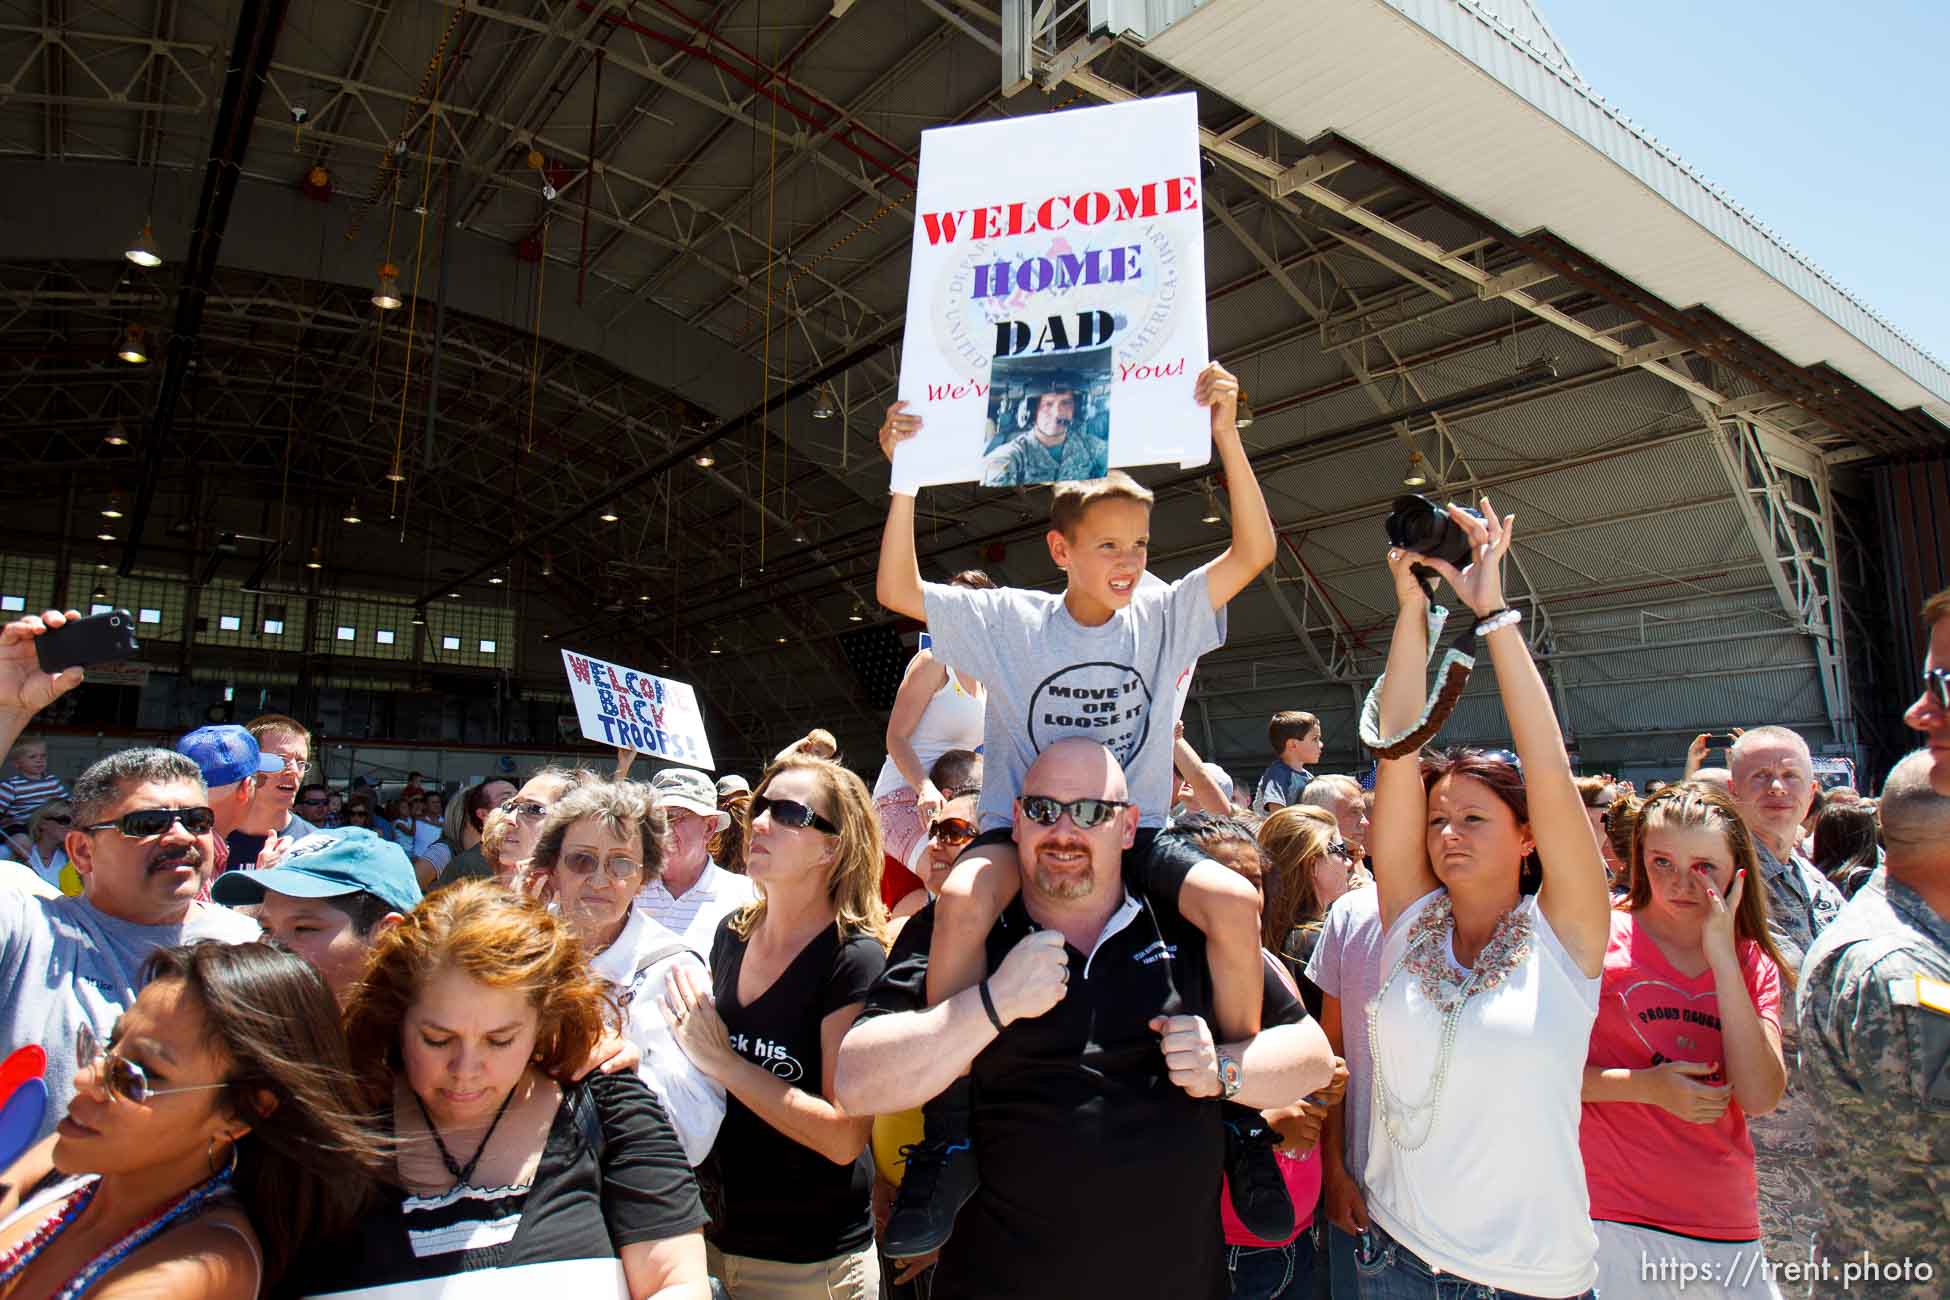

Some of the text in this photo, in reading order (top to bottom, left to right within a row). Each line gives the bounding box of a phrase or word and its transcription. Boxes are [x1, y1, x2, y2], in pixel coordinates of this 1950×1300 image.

[922, 176, 1199, 246] WELCOME
[970, 244, 1143, 299] HOME
[993, 310, 1116, 358] DAD
[1119, 279, 1178, 362] AMERICA
[927, 357, 1185, 402] We'v You!
[597, 688, 666, 728] BACK
[1048, 679, 1139, 700] MOVE IT
[1082, 702, 1116, 714] OR
[597, 714, 699, 761] TROOPS!
[1044, 703, 1142, 728] LOOSE IT
[729, 1033, 787, 1060] ck his
